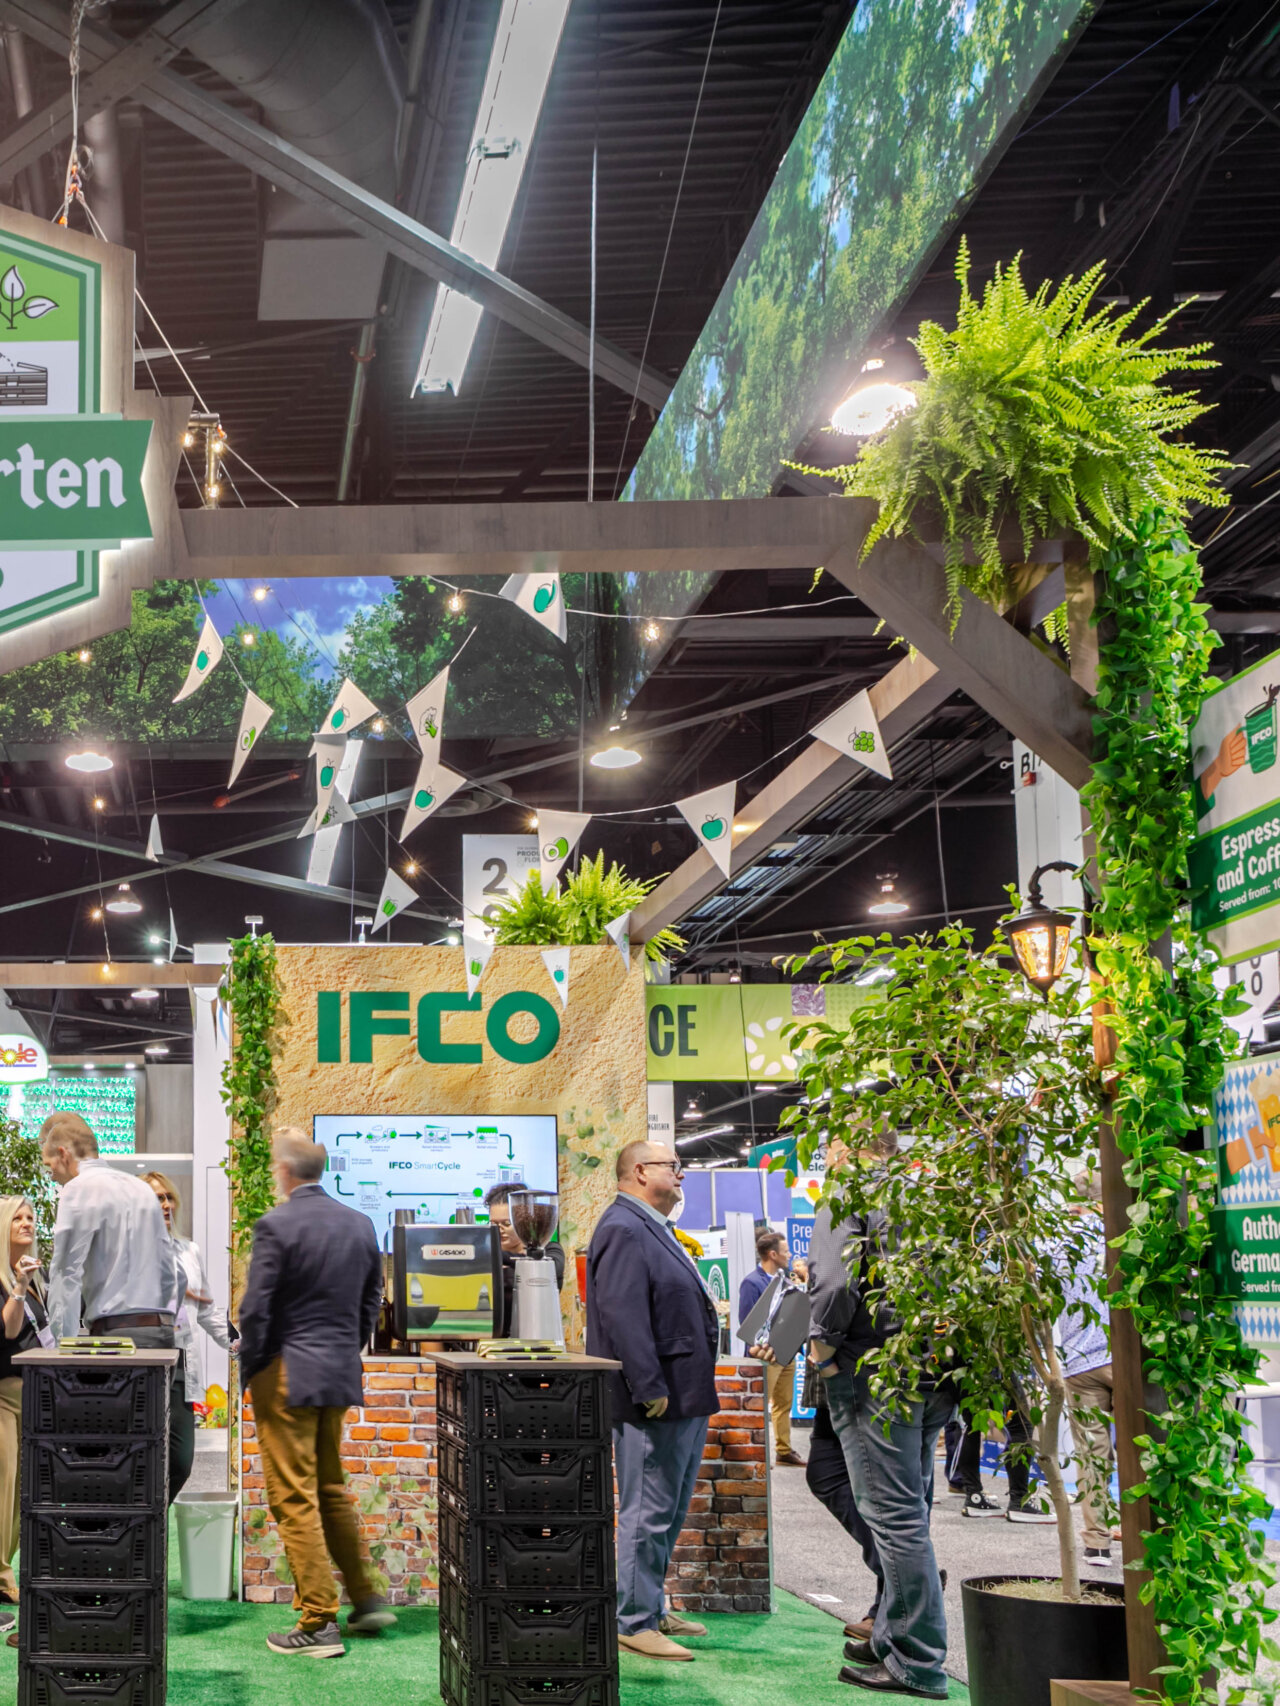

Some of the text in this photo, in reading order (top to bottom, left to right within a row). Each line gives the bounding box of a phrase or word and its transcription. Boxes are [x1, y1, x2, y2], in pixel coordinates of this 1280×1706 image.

[1251, 726, 1273, 746] IFCO
[1217, 860, 1245, 894] and
[1219, 891, 1247, 912] Served
[1248, 885, 1271, 901] from:
[317, 990, 560, 1065] IFCO
[389, 1161, 412, 1169] IFCO
[1241, 1280, 1270, 1293] Served
